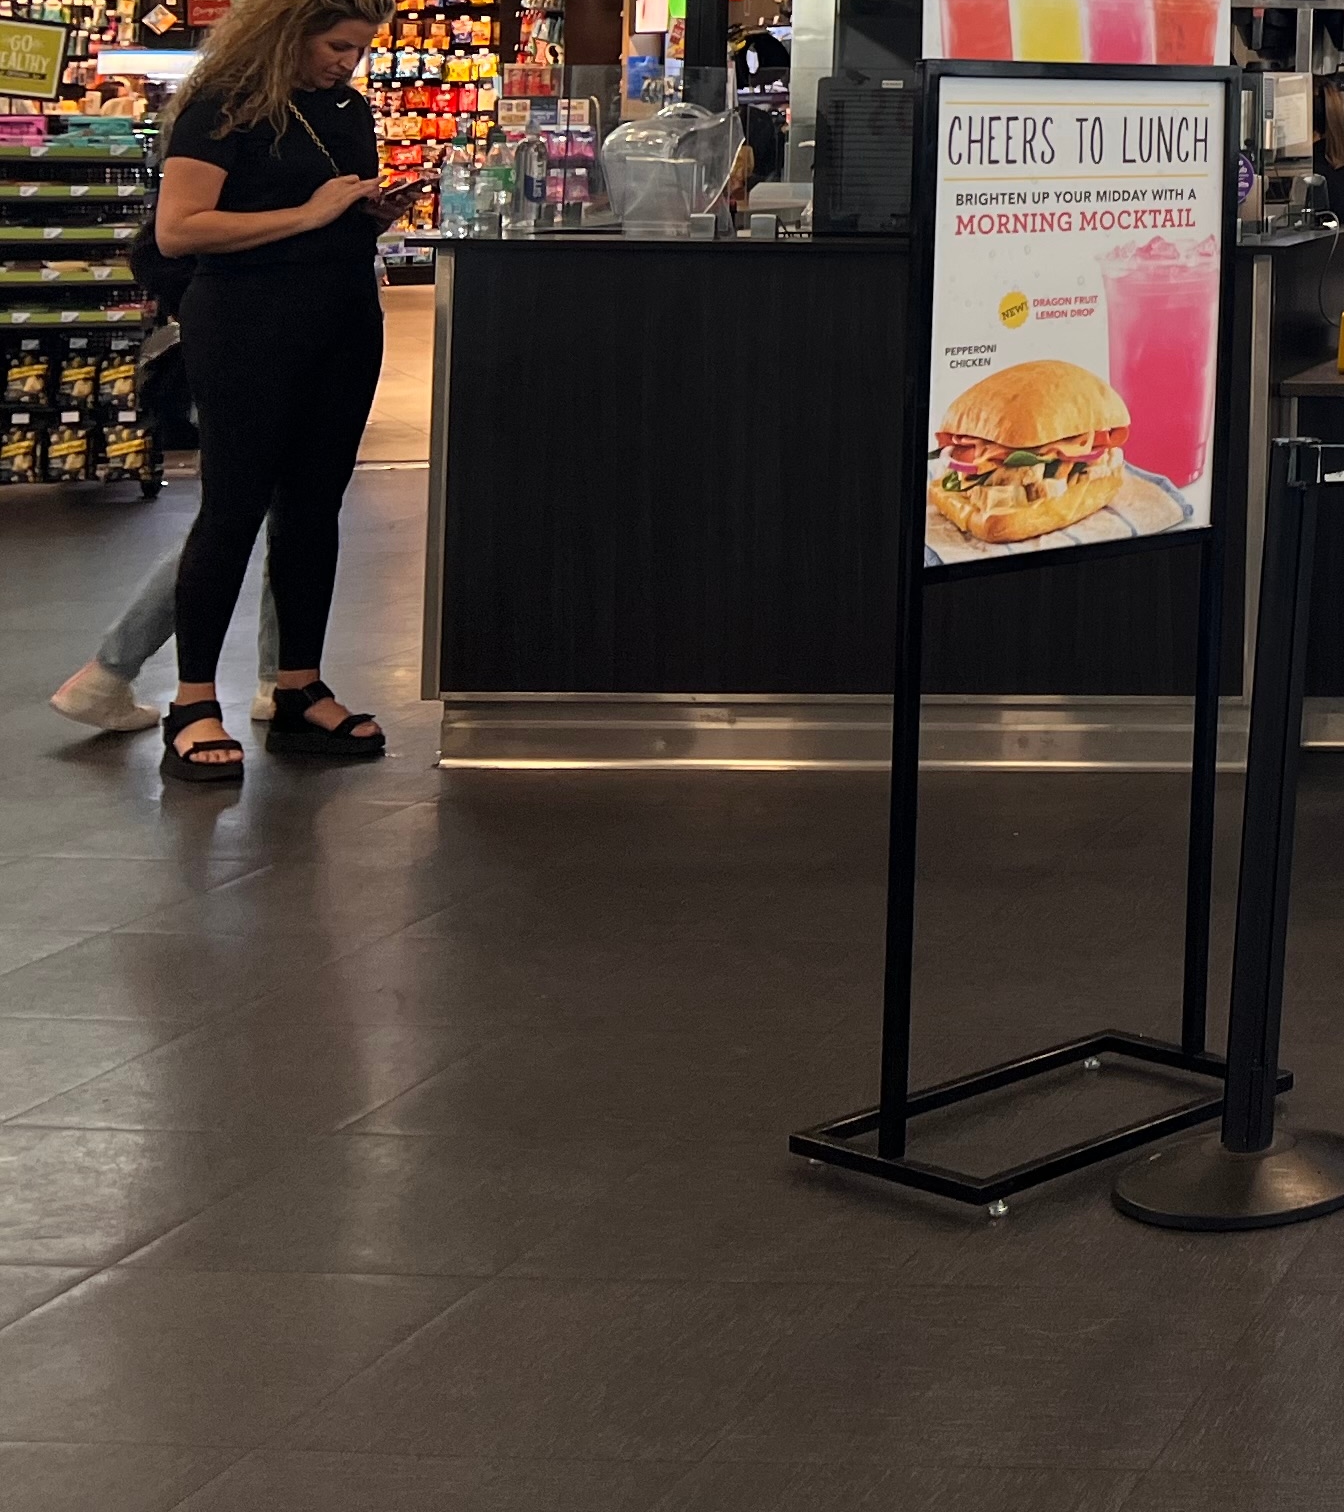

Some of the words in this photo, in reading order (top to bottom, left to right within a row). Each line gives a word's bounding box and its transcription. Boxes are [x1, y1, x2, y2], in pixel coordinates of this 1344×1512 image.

[10, 34, 33, 53] GO
[0, 50, 51, 74] EALTHY
[947, 115, 1056, 165] CHEERS
[1075, 116, 1104, 164] TO
[1122, 116, 1209, 164] LUNCH
[955, 191, 1027, 207] BRIGHTEN
[1032, 191, 1050, 205] UP
[1054, 190, 1092, 204] YOUR
[1096, 189, 1148, 203] MIDDAY
[1151, 188, 1184, 201] WITH
[1187, 188, 1197, 201] A
[955, 211, 1072, 236] MORNING
[1079, 208, 1196, 232] MOCKTAIL
[1001, 300, 1029, 321] NEW!
[1032, 296, 1072, 308] DRAGON
[1074, 295, 1098, 306] FRUIT
[1035, 309, 1068, 320] LEMON
[1070, 308, 1095, 318] DROP
[944, 344, 997, 356] PEPPERONI
[949, 357, 992, 369] CHICKEN
